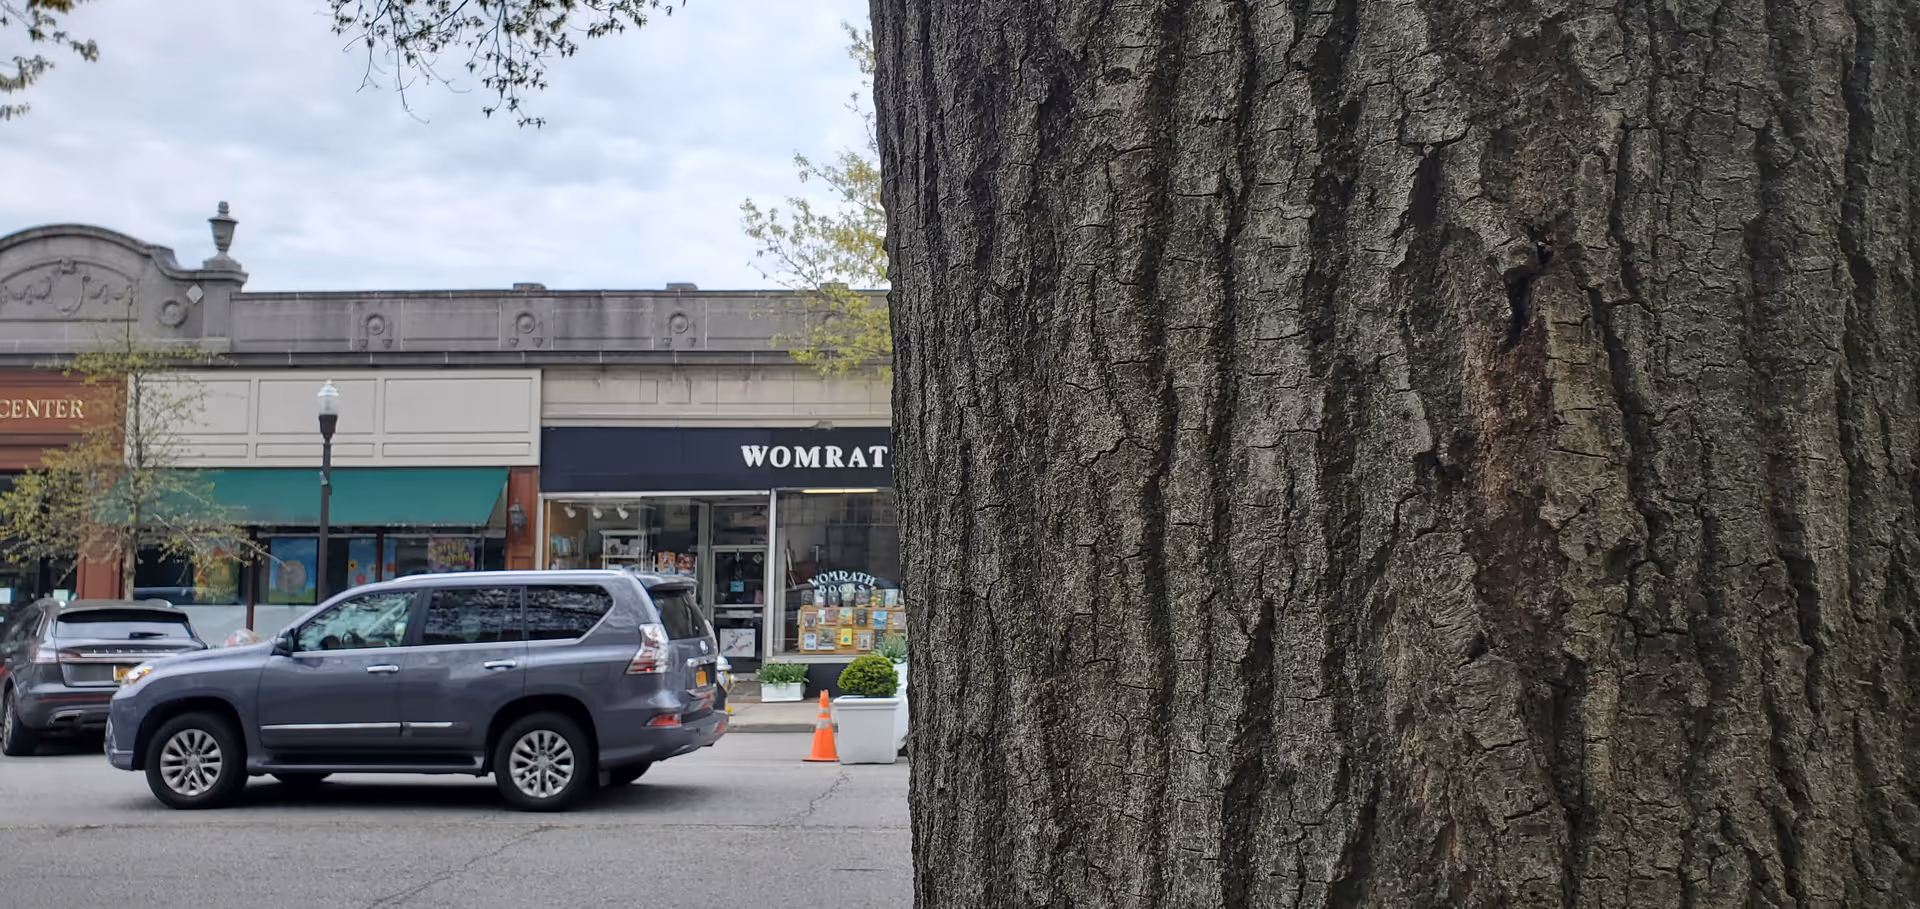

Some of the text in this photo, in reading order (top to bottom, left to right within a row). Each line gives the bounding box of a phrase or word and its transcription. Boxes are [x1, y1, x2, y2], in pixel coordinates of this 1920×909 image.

[0, 399, 85, 419] CENTER
[741, 445, 888, 468] WOMRAT
[808, 570, 876, 586] WOMRATH
